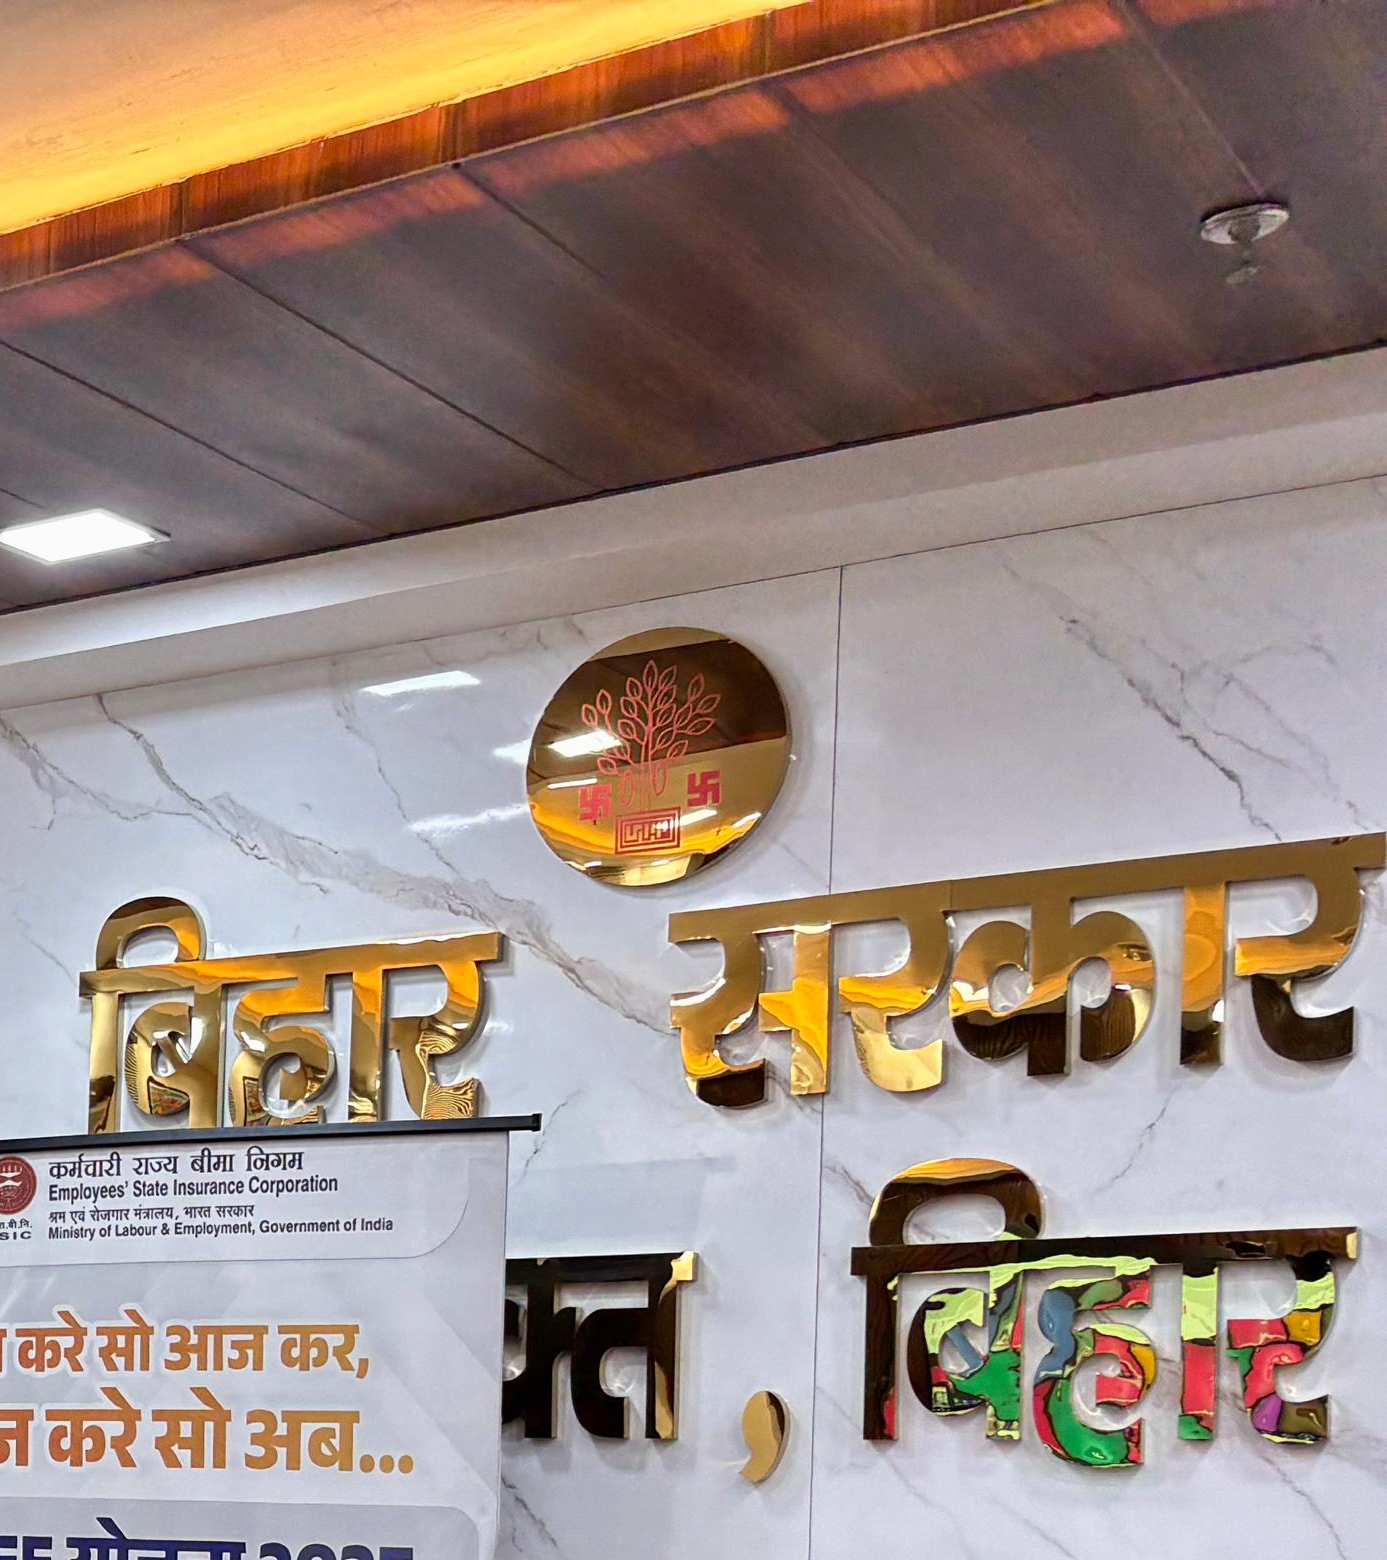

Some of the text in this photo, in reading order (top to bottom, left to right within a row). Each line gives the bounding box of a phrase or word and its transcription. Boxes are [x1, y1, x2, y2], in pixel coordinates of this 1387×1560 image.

[80, 832, 1386, 1129] बिहार सरकार
[49, 1146, 304, 1179] कर्मचारी राज्य बीमा निगम
[49, 1175, 338, 1203] Employees' State Insurance Corporation
[49, 1204, 254, 1223] श्रम एवं रोजगार मंत्रालय, भारत सरकार
[48, 1218, 393, 1241] Ministry of Labour & Employment, Government of India
[851, 1157, 1357, 1468] बिहार
[16, 1311, 87, 1373] करे
[96, 1309, 154, 1371] सो
[164, 1324, 267, 1372] आज
[278, 1324, 371, 1379] कर,
[46, 1387, 142, 1468] करे
[153, 1387, 231, 1469] सो
[245, 1409, 415, 1474] अब...
